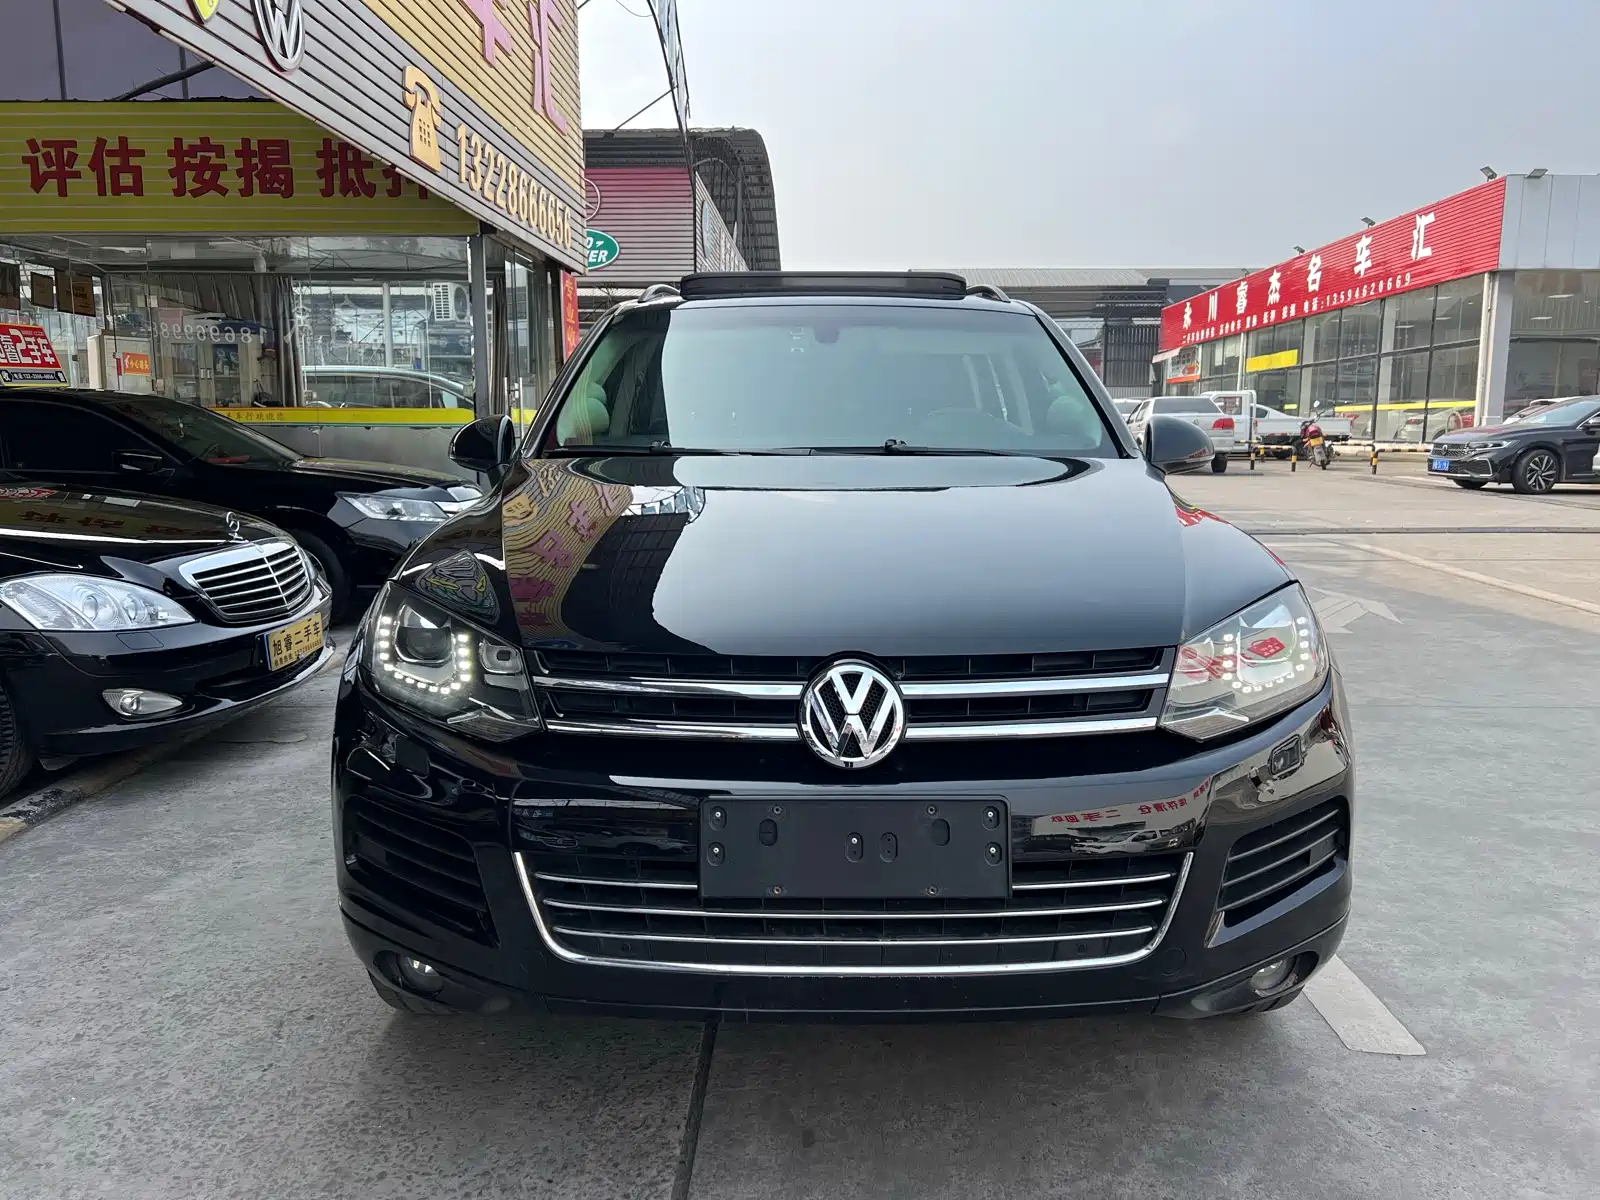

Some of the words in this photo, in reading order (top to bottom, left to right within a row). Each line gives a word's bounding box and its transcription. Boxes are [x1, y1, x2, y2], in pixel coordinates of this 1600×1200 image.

[21, 137, 146, 198] 评估
[167, 136, 295, 199] 按揭
[456, 123, 572, 249] 13228666656
[1183, 212, 1435, 330] 永川睿杰名车汇
[273, 621, 321, 657] 旭睿二手车
